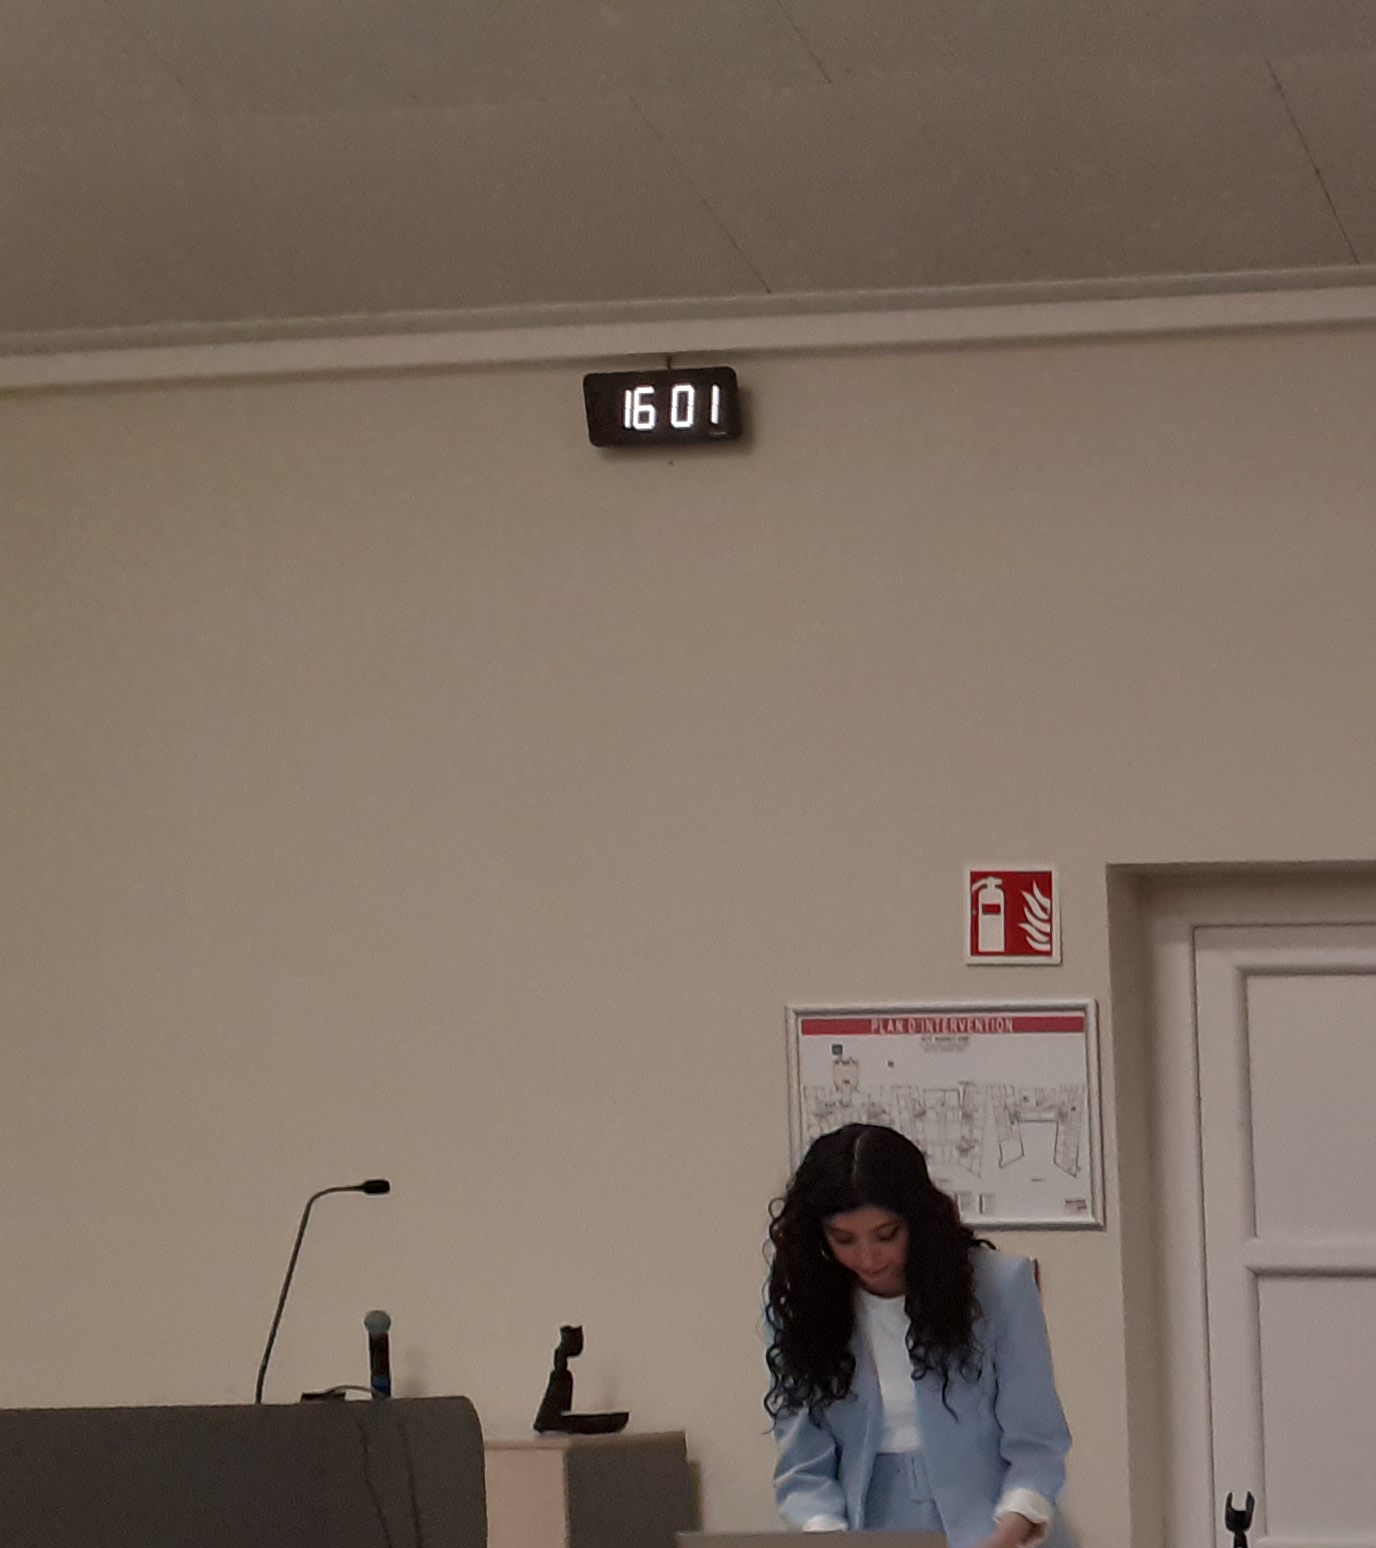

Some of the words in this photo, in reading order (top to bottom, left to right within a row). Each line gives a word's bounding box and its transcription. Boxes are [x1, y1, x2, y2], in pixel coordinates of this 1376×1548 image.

[624, 386, 656, 430] 16
[671, 384, 720, 428] 01
[871, 1018, 904, 1034] PLAN
